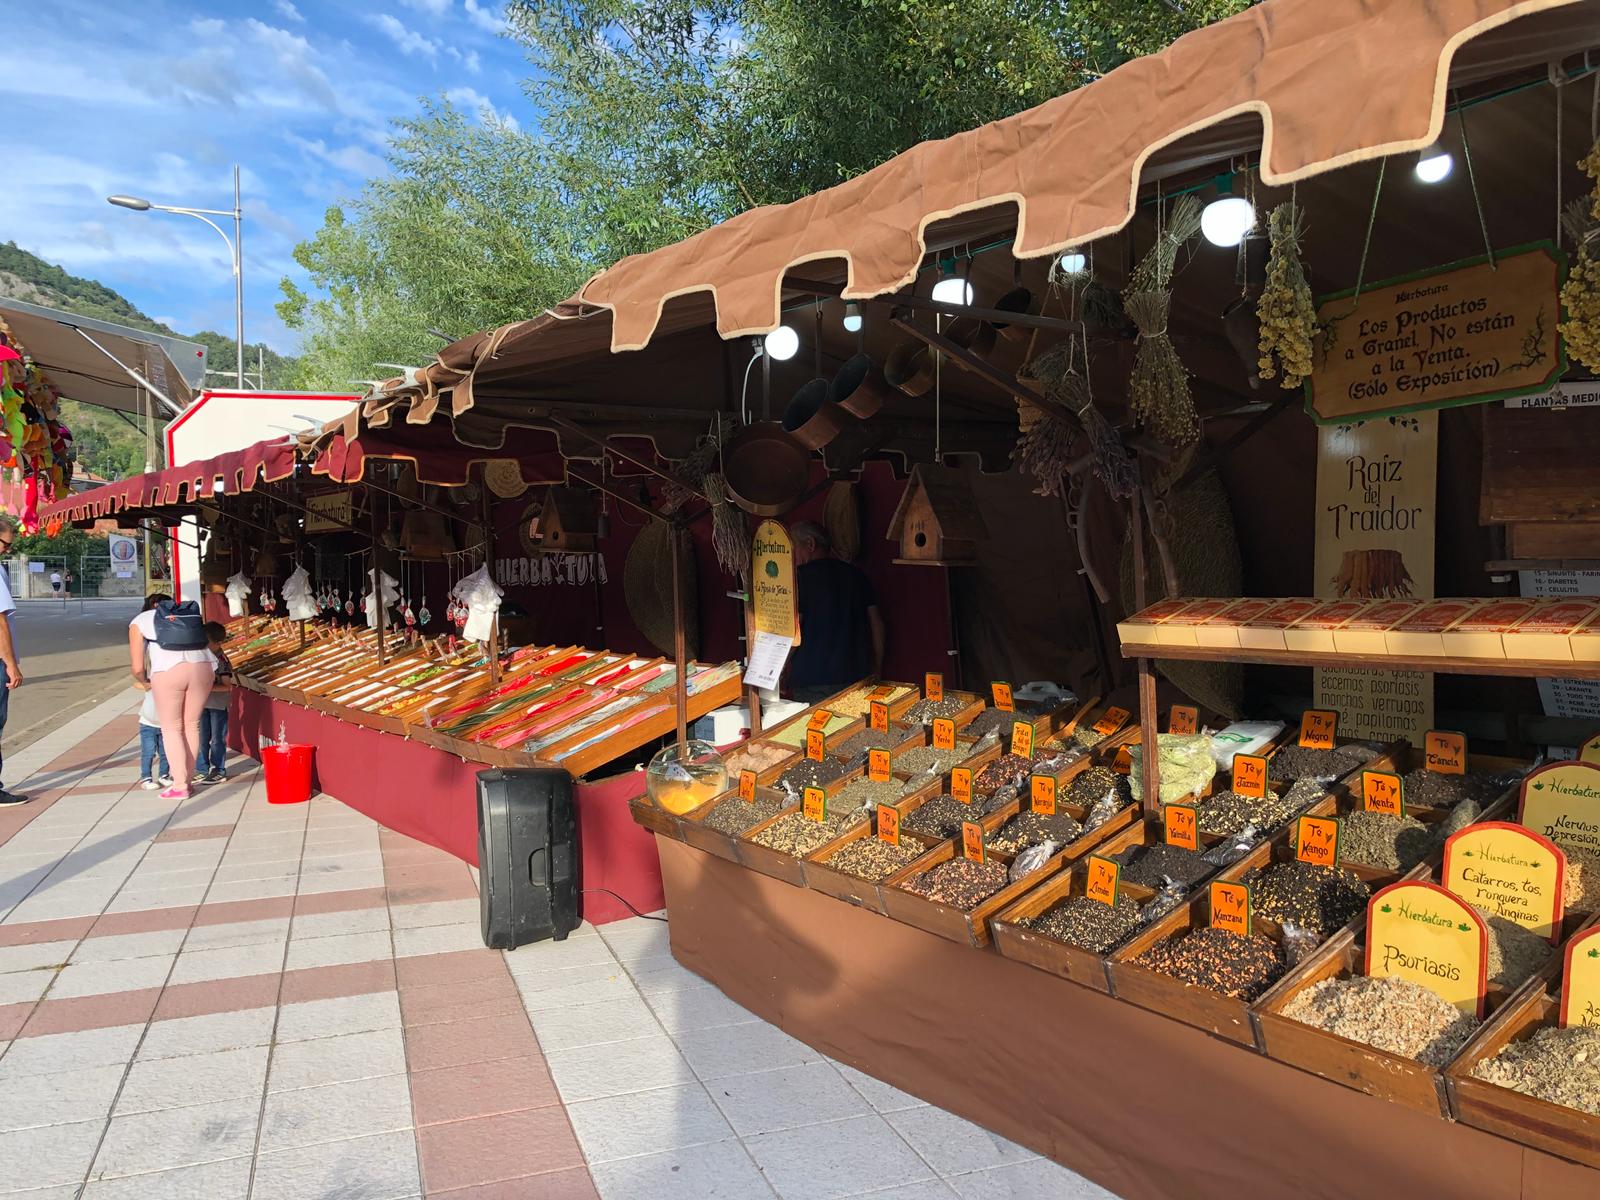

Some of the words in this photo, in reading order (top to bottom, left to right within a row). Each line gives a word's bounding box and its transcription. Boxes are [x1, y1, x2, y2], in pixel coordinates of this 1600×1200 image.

[1359, 320, 1388, 338] Los
[1396, 297, 1488, 336] Productos
[1344, 349, 1355, 360] a
[1430, 324, 1456, 349] No
[1466, 313, 1516, 334] están
[1372, 364, 1382, 375] a
[1390, 356, 1405, 371] la
[1413, 345, 1471, 372] Venta.
[1521, 395, 1569, 408] PLANTAS
[1364, 484, 1381, 504] del
[1327, 495, 1422, 540] Traidor
[1321, 676, 1364, 692] eccemas
[1370, 680, 1420, 697] psoriasis
[1321, 693, 1364, 709] manchas
[1371, 697, 1425, 716] verrugas
[1355, 712, 1418, 732] papilomas
[1304, 728, 1329, 743] Negro
[1426, 752, 1460, 768] Canela
[1371, 779, 1386, 792] Té
[1368, 794, 1395, 809] Menta
[1308, 823, 1322, 837] Té
[1300, 840, 1328, 857] Mango
[1476, 839, 1528, 867] Hierbatura
[1462, 867, 1518, 893] Catarros,
[1220, 890, 1234, 904] Té
[1475, 887, 1528, 907] ronquera
[1212, 906, 1243, 926] Manzana
[1398, 897, 1453, 929] Hierbatura
[1383, 944, 1461, 982] Psoriasis
